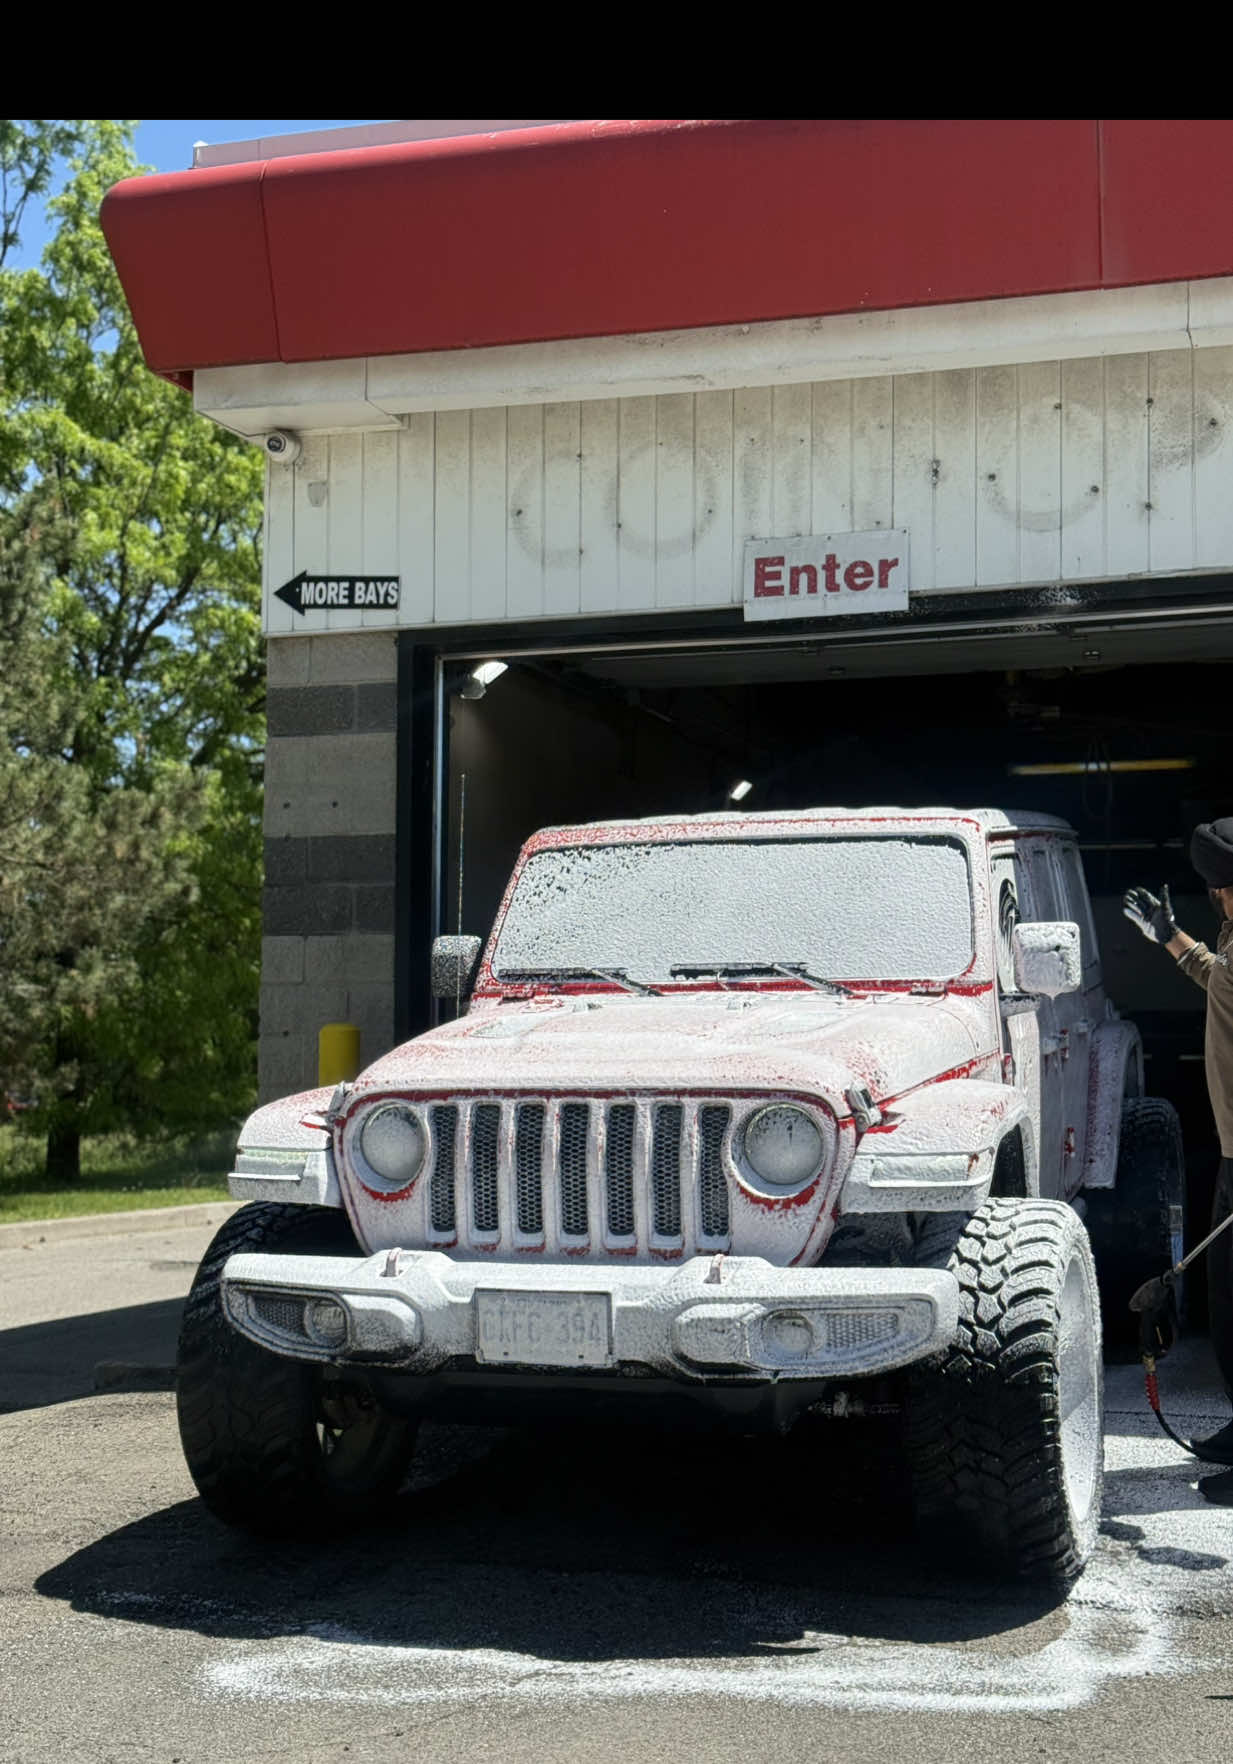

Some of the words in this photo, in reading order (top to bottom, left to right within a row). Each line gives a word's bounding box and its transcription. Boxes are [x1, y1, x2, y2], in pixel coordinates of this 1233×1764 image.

[301, 582, 350, 605] MORE
[354, 581, 398, 605] BAYS
[754, 554, 899, 598] Enter
